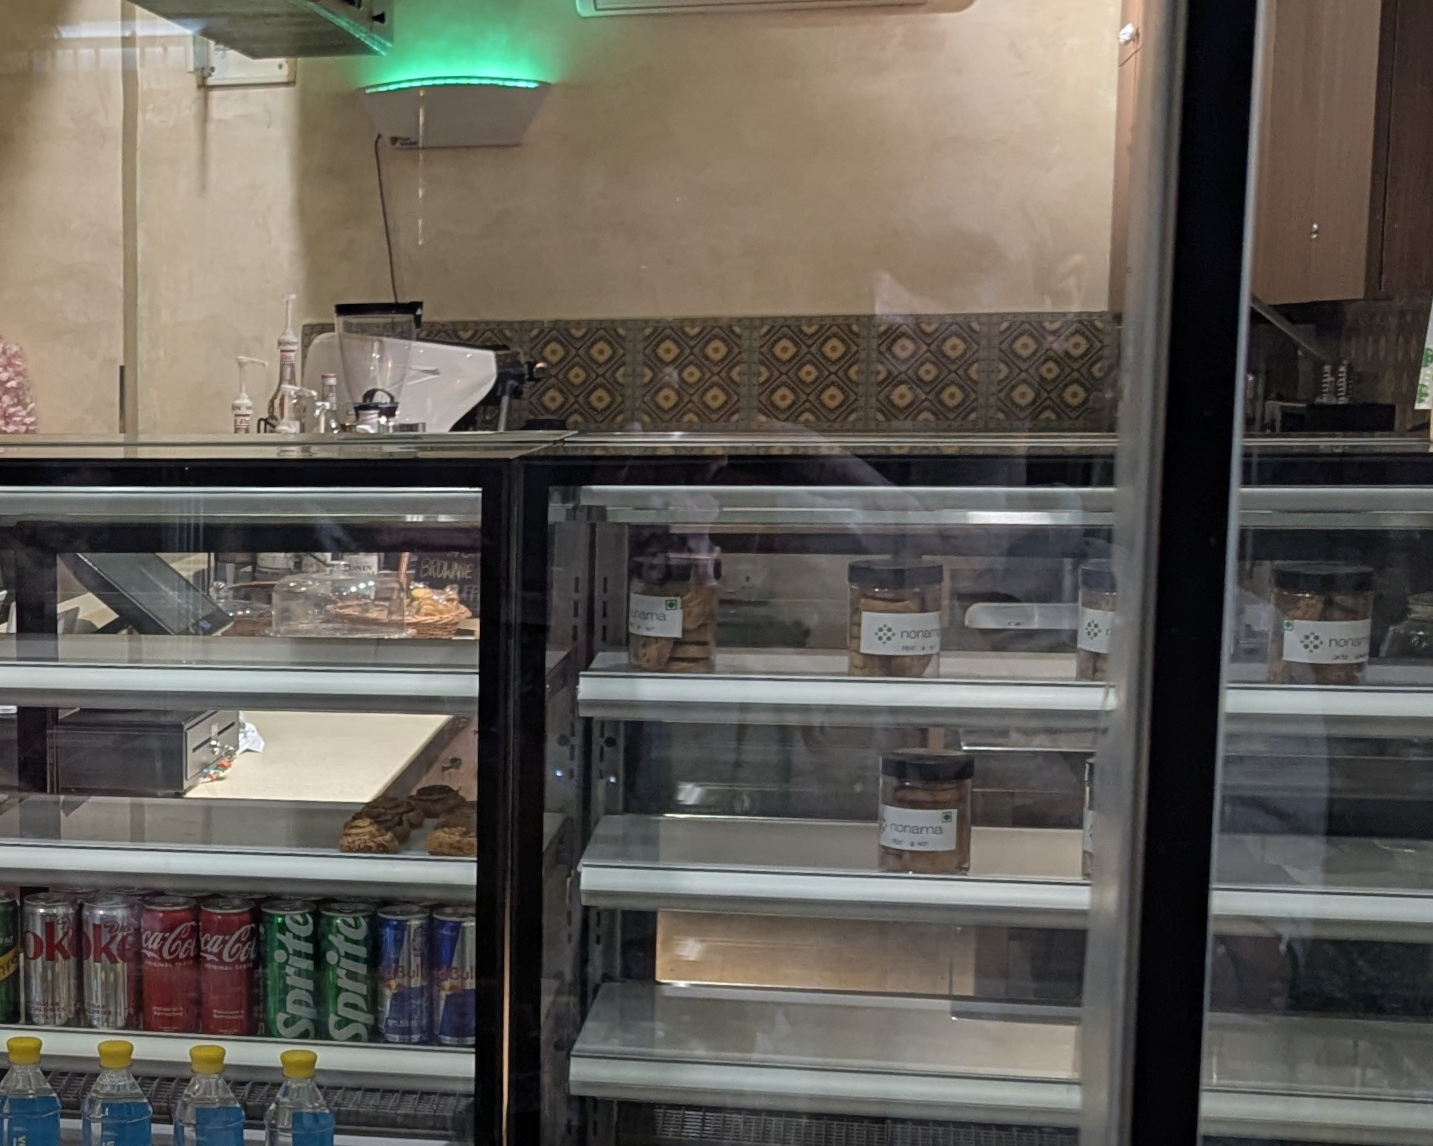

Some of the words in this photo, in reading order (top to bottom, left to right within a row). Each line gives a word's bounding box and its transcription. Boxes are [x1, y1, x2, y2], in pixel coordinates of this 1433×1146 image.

[420, 557, 474, 579] BROWNIE
[890, 822, 943, 835] nonama
[20, 921, 79, 962] ok
[142, 920, 198, 960] ca-Col
[199, 923, 257, 962] ca-Col
[273, 912, 318, 1040] Sprite
[325, 915, 375, 1042] Sprite
[450, 964, 475, 981] Bul
